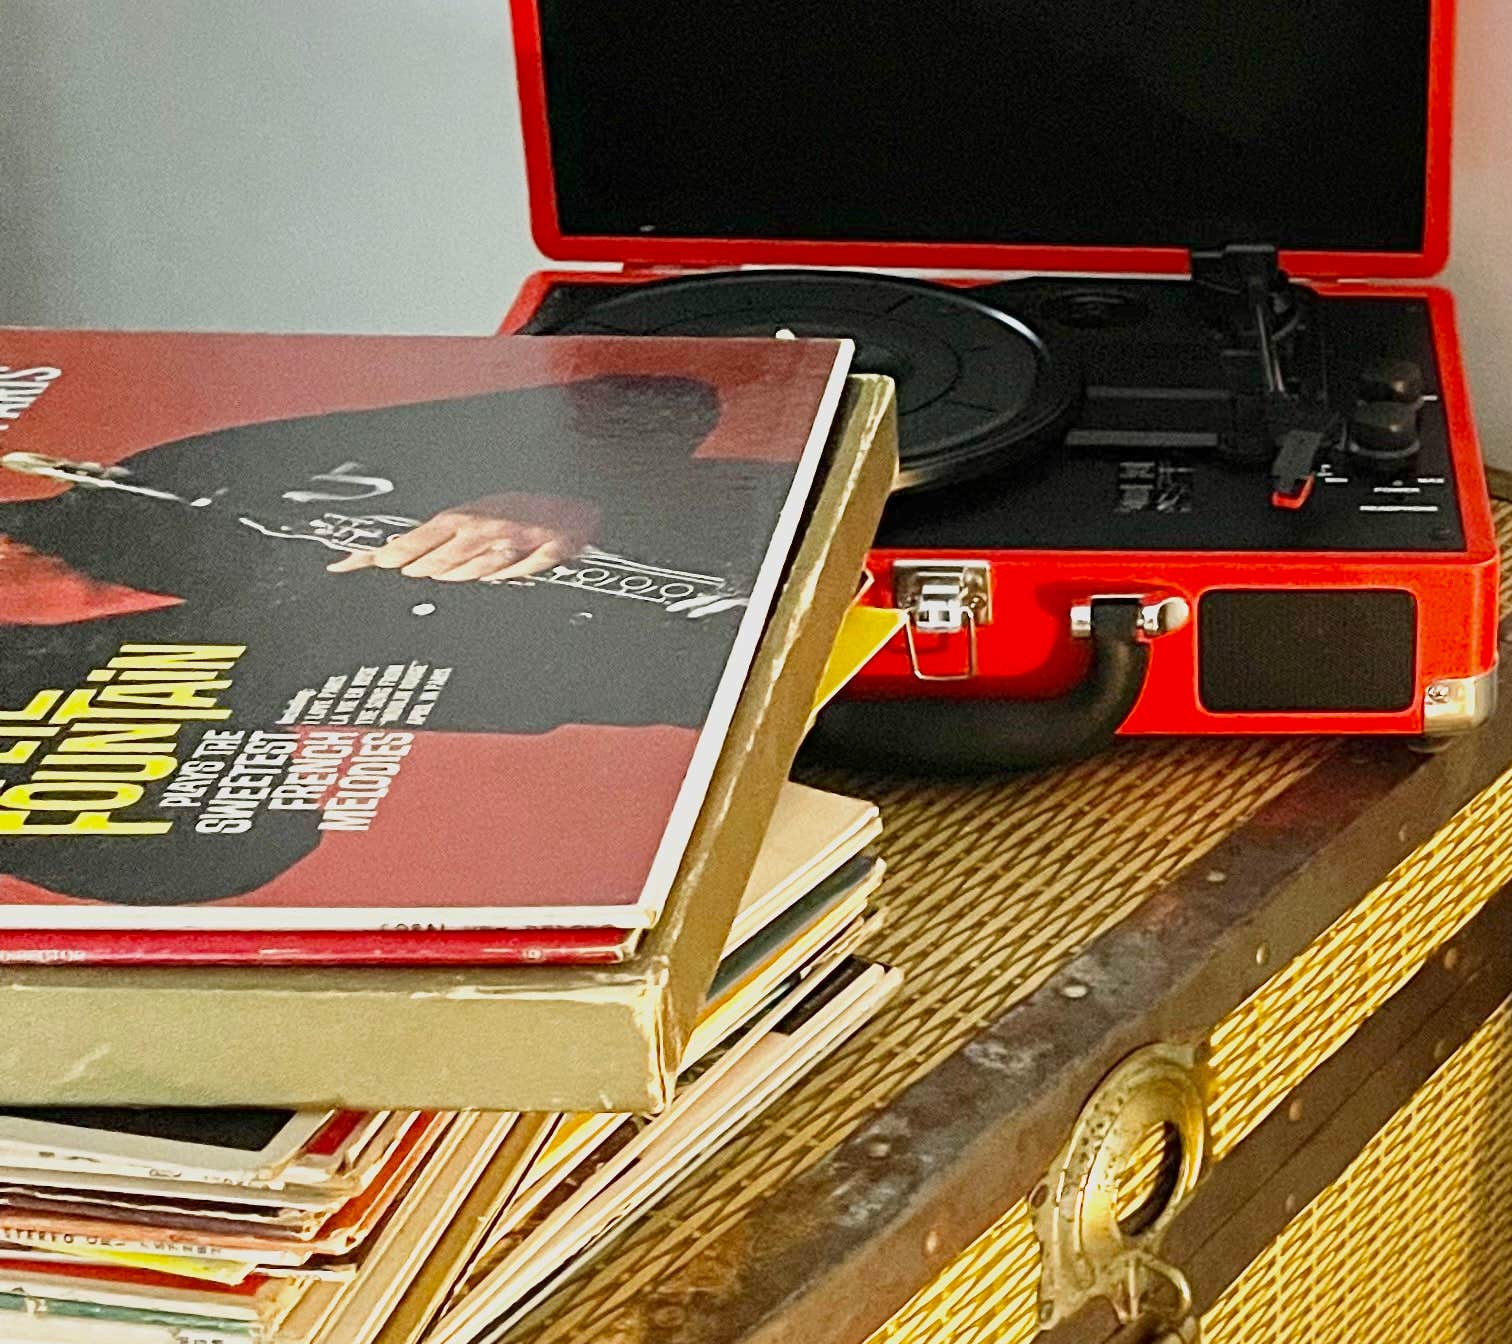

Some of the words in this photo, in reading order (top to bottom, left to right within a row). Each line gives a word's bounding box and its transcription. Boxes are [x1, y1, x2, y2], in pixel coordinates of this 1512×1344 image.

[158, 759, 219, 808] PLAYS
[195, 729, 247, 760] THE
[194, 731, 301, 835] SWEETEST
[268, 731, 360, 811] FRENCH
[317, 732, 416, 832] MELODIES
